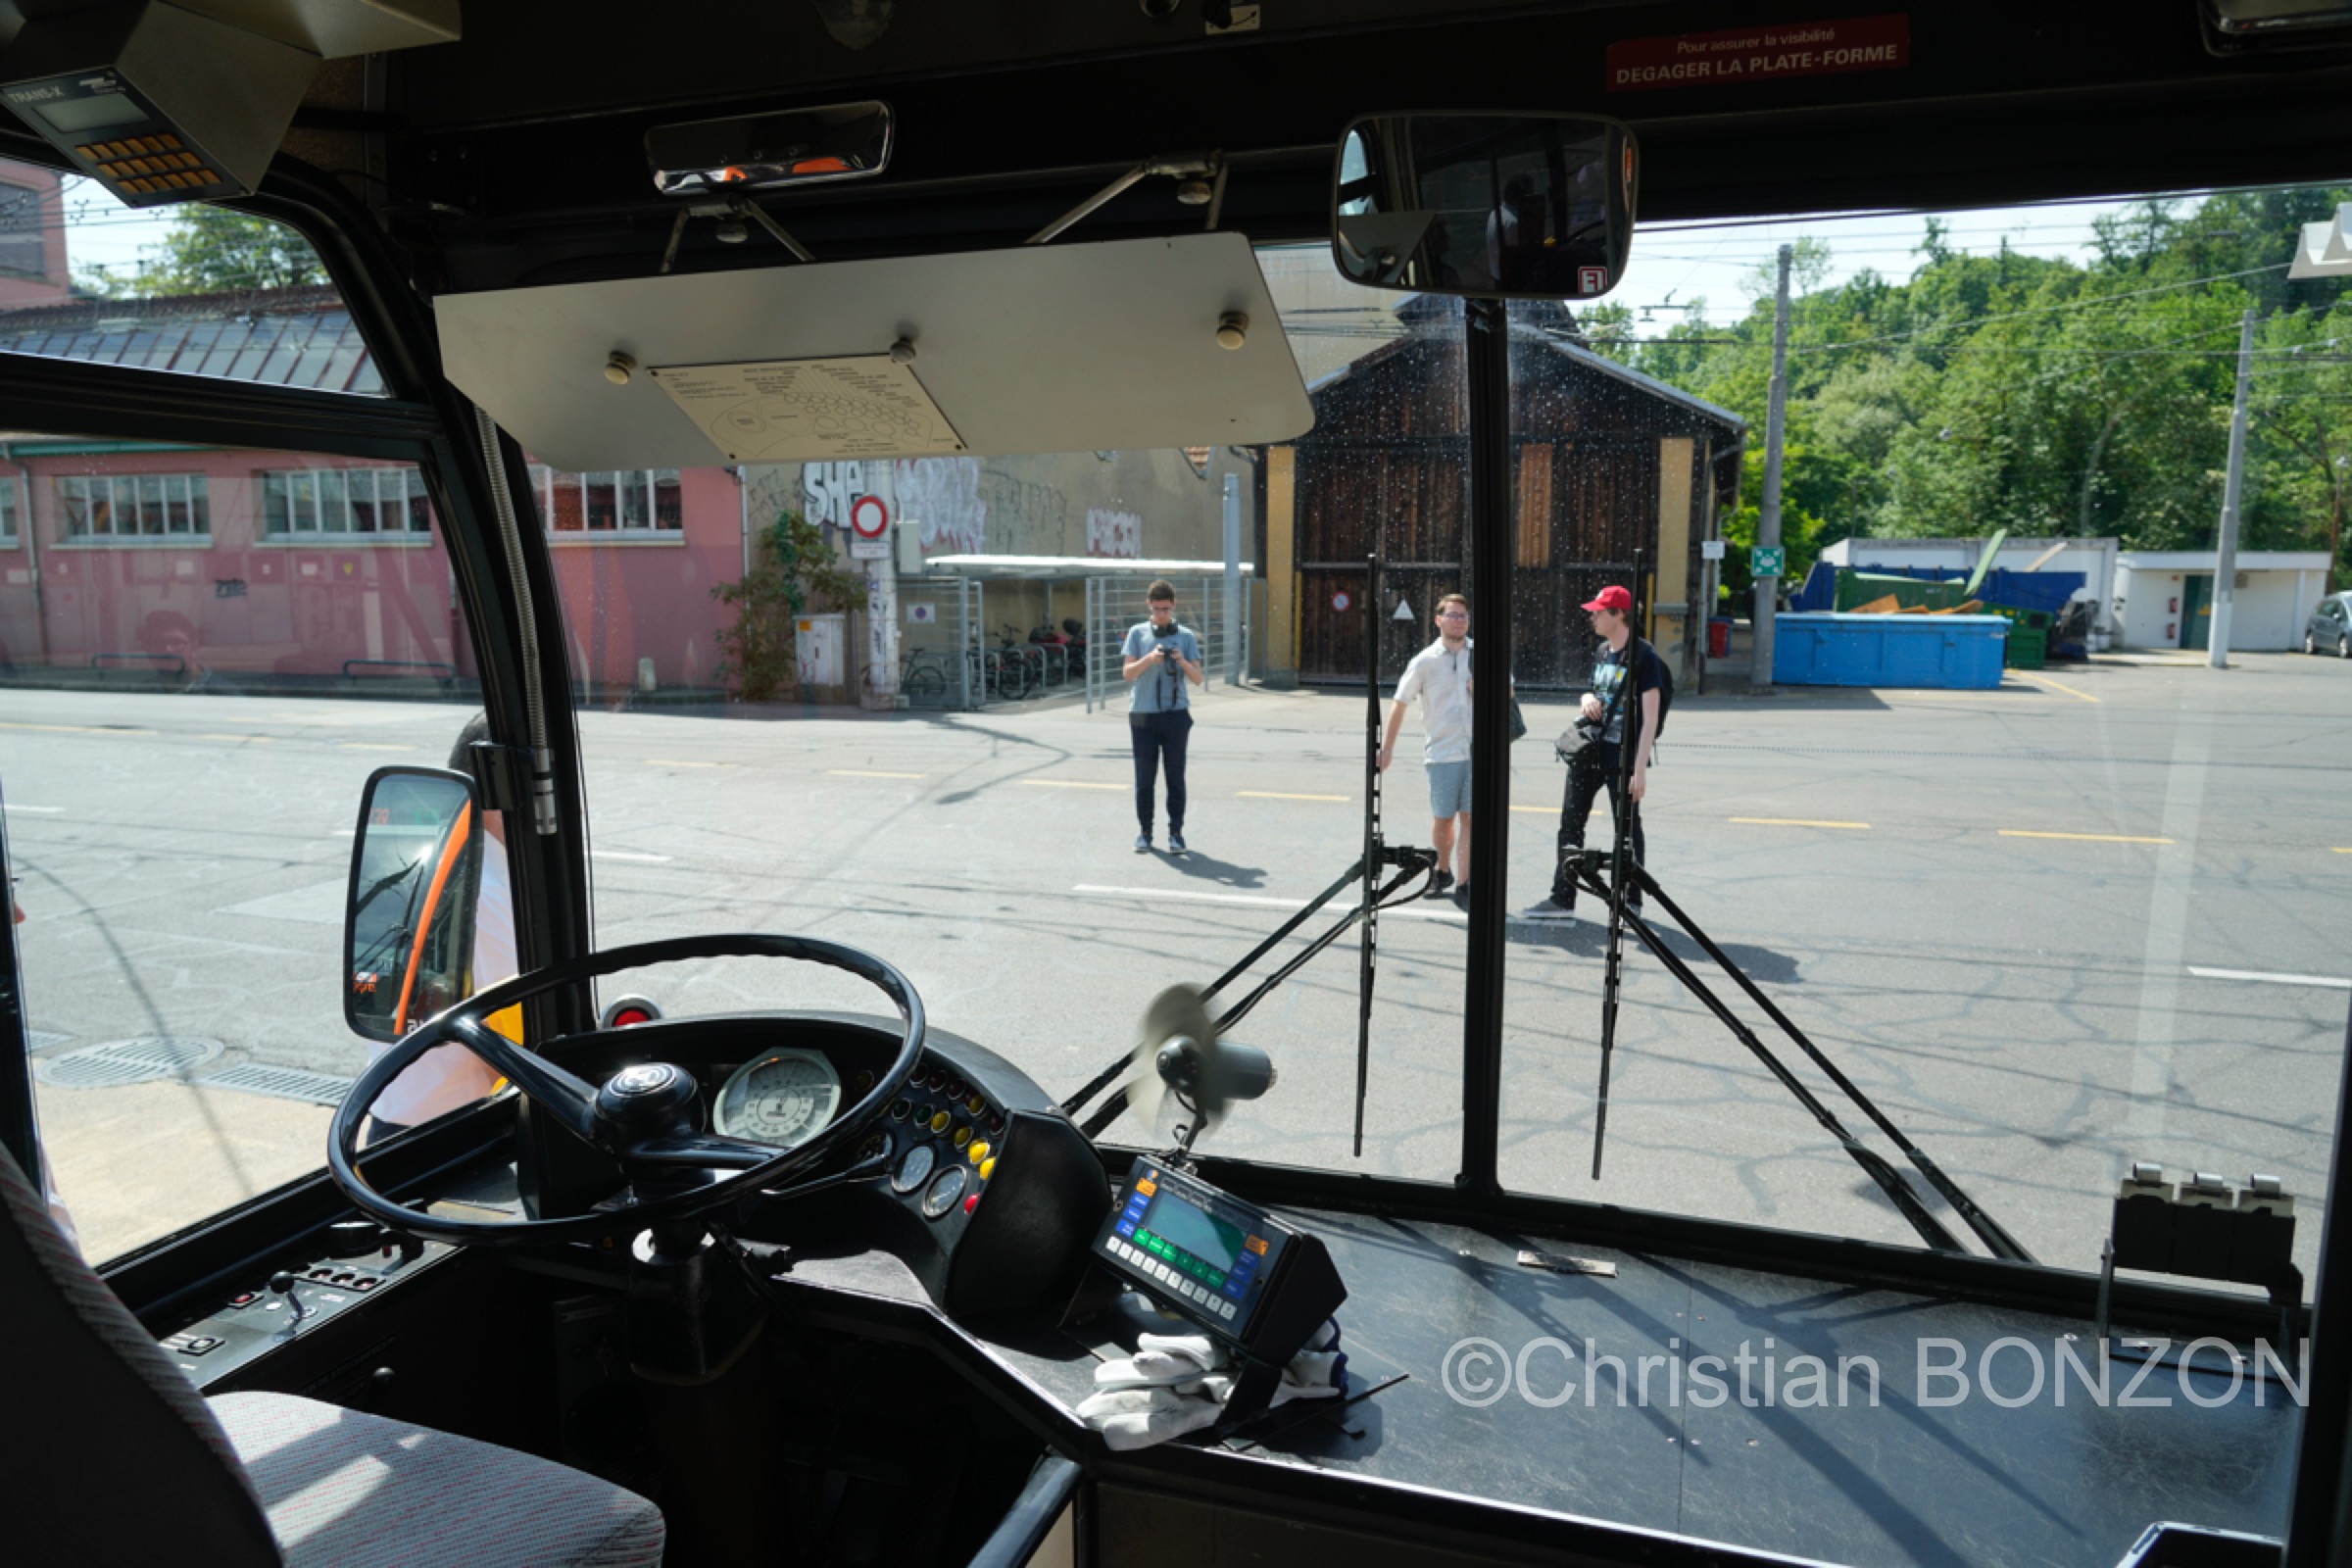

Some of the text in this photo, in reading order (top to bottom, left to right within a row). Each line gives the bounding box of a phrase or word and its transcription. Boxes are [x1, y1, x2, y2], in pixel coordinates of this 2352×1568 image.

[1677, 26, 1836, 54] Pour assurer la visibilité
[1616, 43, 1898, 84] DEGAGER LA PLATE-FORME
